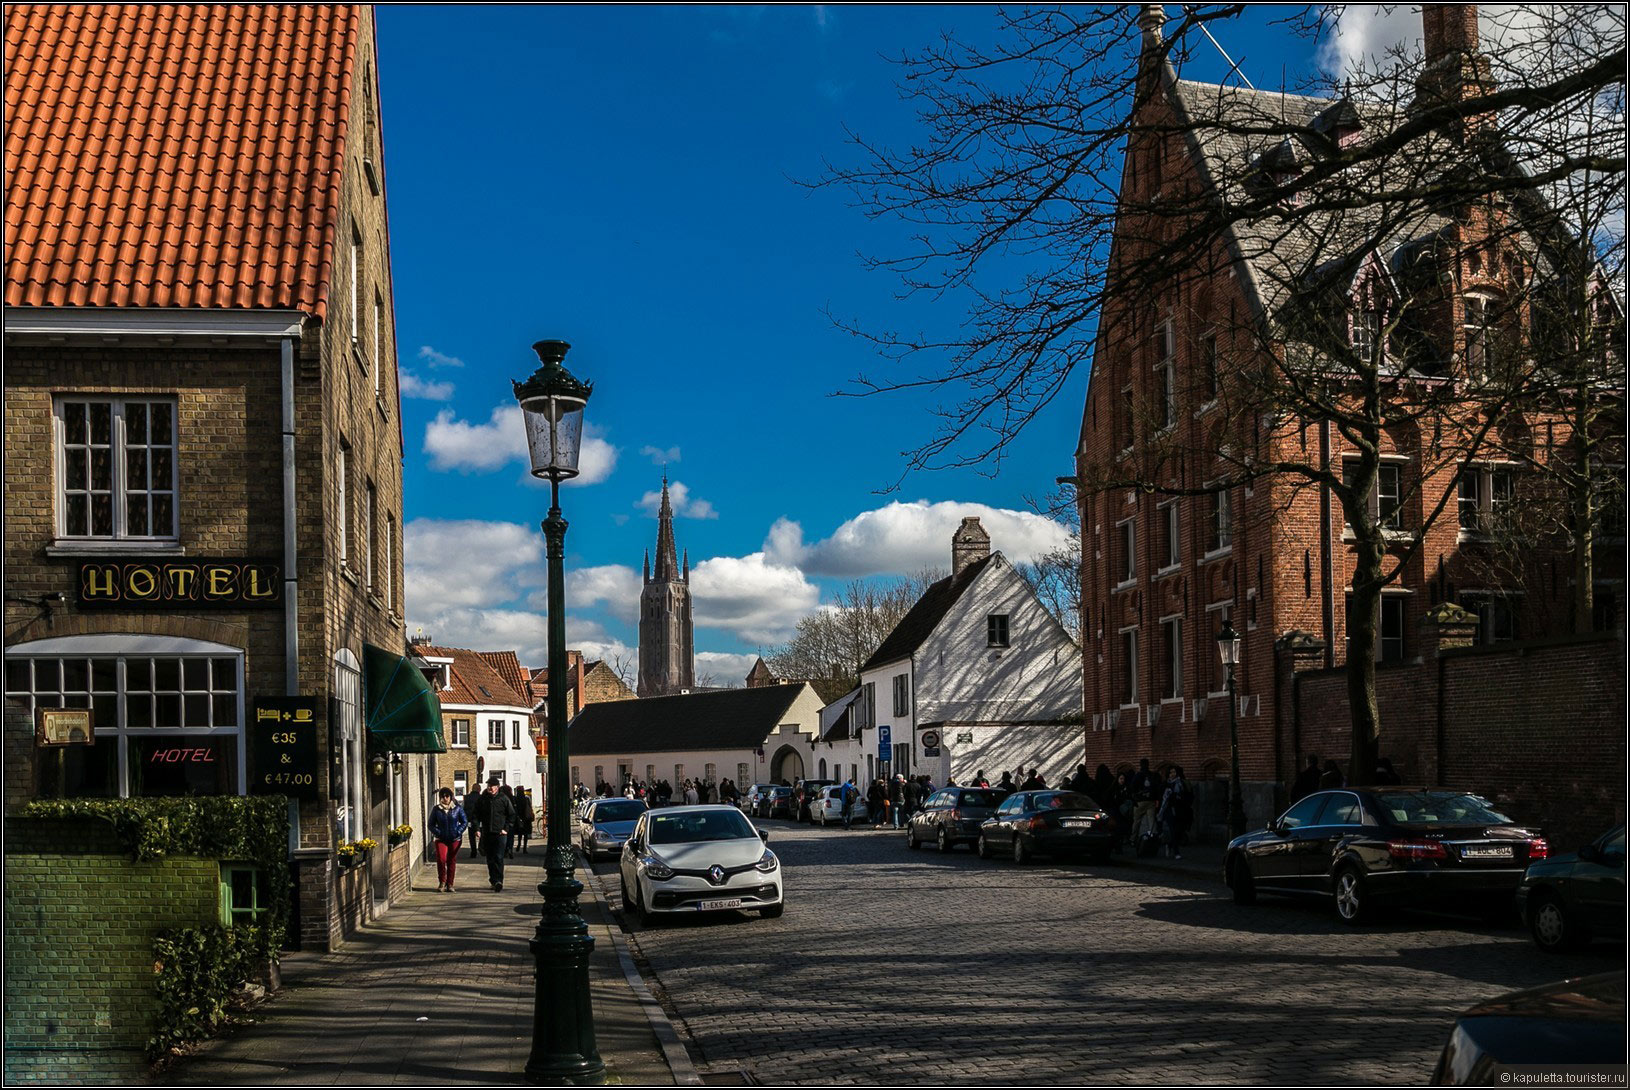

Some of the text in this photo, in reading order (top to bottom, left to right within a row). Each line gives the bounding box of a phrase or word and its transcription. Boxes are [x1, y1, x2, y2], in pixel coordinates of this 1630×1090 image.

[89, 568, 273, 596] HOTEL
[272, 732, 296, 743] €35
[880, 728, 889, 741] P
[151, 748, 214, 762] HOTEL
[280, 753, 292, 763] &
[702, 900, 740, 909] 1-EKS-403
